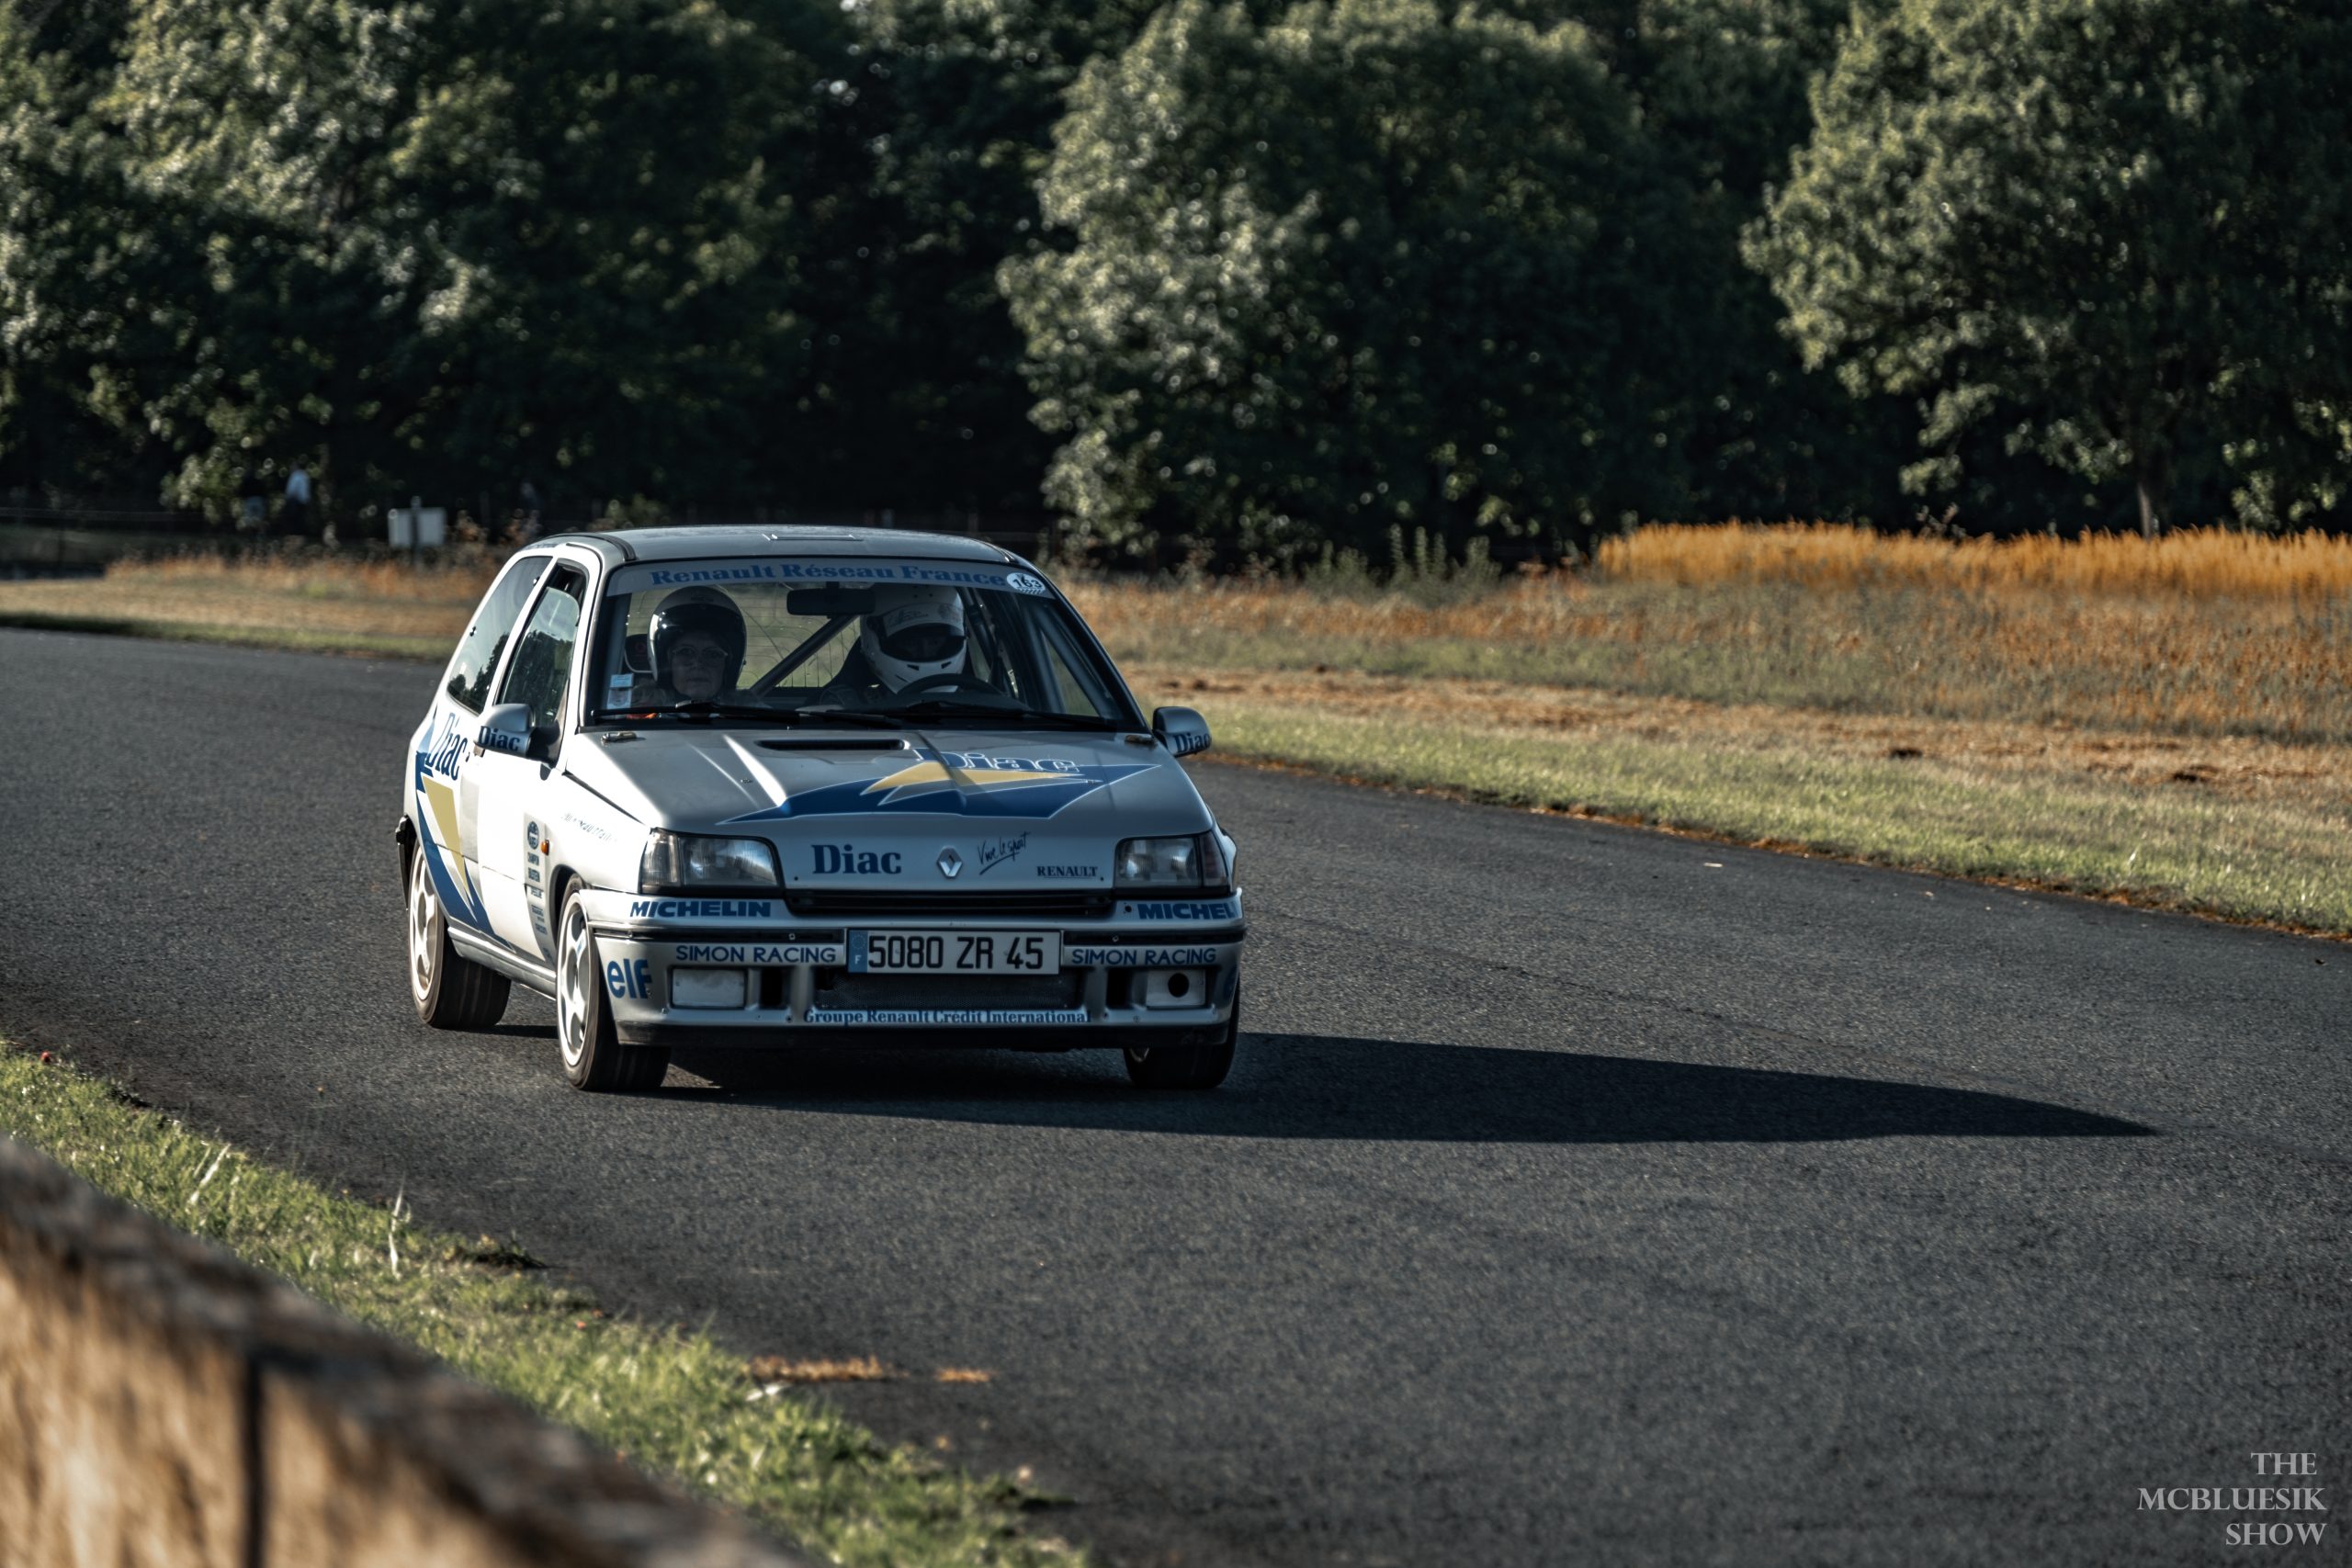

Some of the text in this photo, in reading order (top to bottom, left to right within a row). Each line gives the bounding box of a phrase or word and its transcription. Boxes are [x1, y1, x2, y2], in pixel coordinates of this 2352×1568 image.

[650, 563, 1006, 587] Renault Réseau France
[1012, 575, 1042, 588] 163
[424, 712, 468, 781] Diac
[478, 725, 521, 751] Diac
[912, 747, 1080, 773] Diac
[810, 843, 902, 875] Diac
[1036, 865, 1098, 877] RENAULT
[629, 900, 772, 918] MICHELIN
[675, 945, 837, 964] SIMON RACING
[854, 954, 862, 964] F
[868, 935, 1045, 970] 5080 ZR 45
[1071, 947, 1217, 965] SIMON RACING
[606, 958, 653, 999] elf
[803, 1010, 864, 1027] Groupe
[866, 1010, 930, 1024] Renault
[986, 1010, 1091, 1024] International
